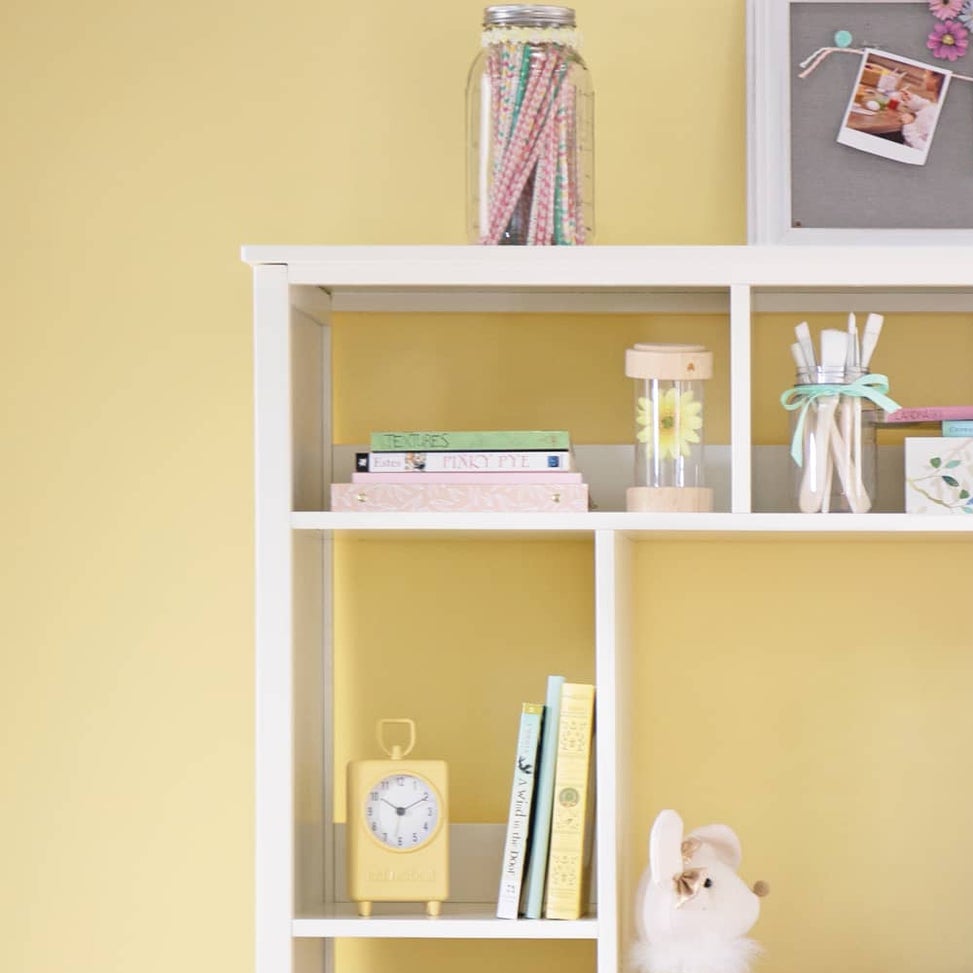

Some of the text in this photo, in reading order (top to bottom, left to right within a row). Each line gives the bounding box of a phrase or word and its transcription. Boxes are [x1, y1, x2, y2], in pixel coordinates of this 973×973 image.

[383, 433, 449, 449] TEXTURES
[443, 454, 530, 469] PINKY PYE
[518, 778, 528, 786] A
[515, 789, 528, 817] Wind
[507, 850, 519, 874] Door
